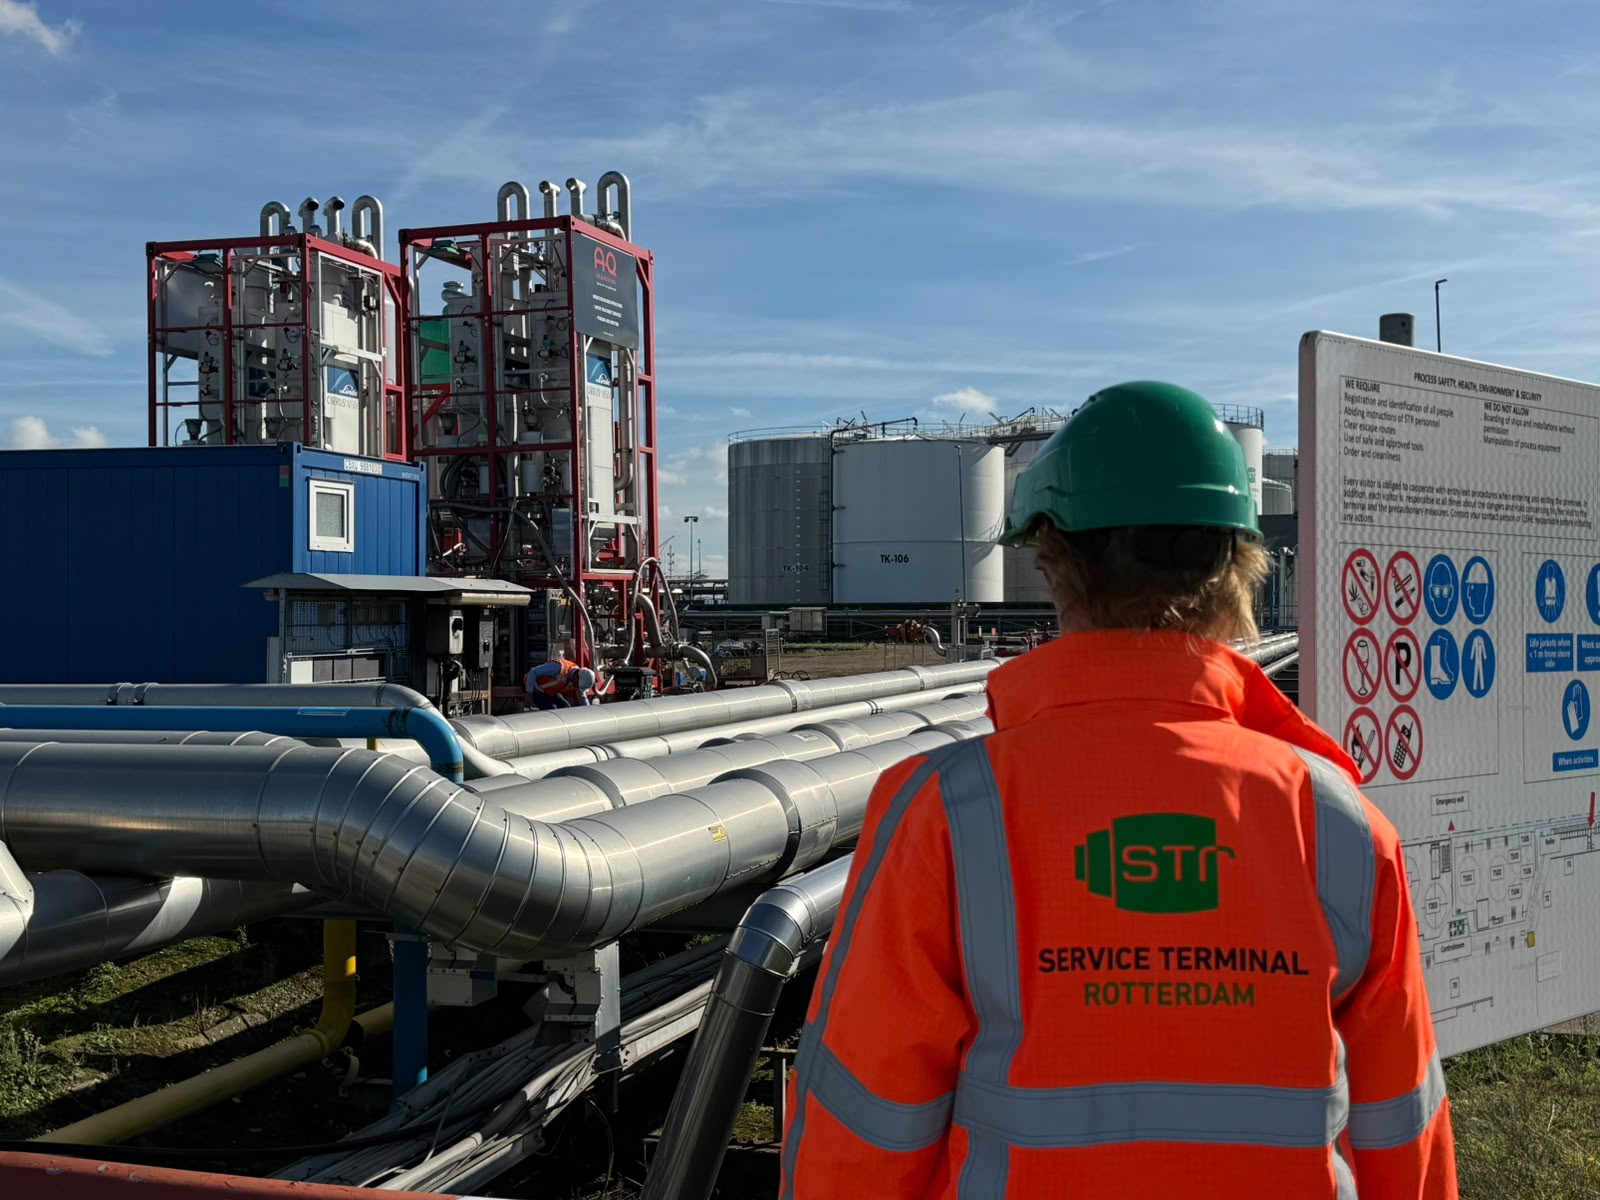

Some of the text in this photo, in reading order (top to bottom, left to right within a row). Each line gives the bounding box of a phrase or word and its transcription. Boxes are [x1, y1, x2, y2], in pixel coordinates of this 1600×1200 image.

[1345, 379, 1380, 393] WE REQUIRE
[1414, 372, 1542, 402] PROCESS SAFETY, HEALTH, ENVIRONMENT & SECURITY
[1344, 392, 1376, 404] Registration
[1378, 399, 1387, 407] and
[1389, 400, 1422, 412] identification
[1424, 404, 1428, 413] of
[1436, 408, 1454, 418] people
[1484, 402, 1529, 416] WE DO NOT ALLOW
[1344, 406, 1364, 420] Abiding
[1366, 408, 1396, 422] instructions
[1398, 414, 1403, 422] of
[1415, 417, 1440, 428] personnel
[1484, 412, 1504, 425] Boarding
[1506, 416, 1510, 424] of
[1511, 418, 1522, 427] ships
[1523, 420, 1531, 428] and
[1559, 424, 1575, 434] without
[1344, 419, 1396, 435] Clear escape routes
[1344, 432, 1424, 452] Use of safe and approved tools
[1484, 436, 1514, 447] Manipulation
[1514, 439, 1520, 448] of
[1520, 441, 1536, 450] process
[1344, 446, 1400, 462] Order and cleanliness
[1344, 476, 1358, 488] Every
[1360, 478, 1376, 488] visitor
[1382, 480, 1401, 492] obliged
[1402, 483, 1408, 491] to
[1409, 484, 1434, 494] cooperate
[1368, 491, 1380, 500] each
[1406, 494, 1434, 504] responsible
[1344, 501, 1366, 510] terminal
[1368, 502, 1378, 512] and
[1378, 504, 1388, 512] the
[1344, 513, 1353, 522] any
[880, 554, 910, 564] TK-106
[1540, 637, 1556, 649] jackets
[1558, 637, 1570, 647] when
[1582, 640, 1594, 648] Work
[1544, 649, 1556, 658] from
[1038, 946, 1310, 975] SERVICE TERMINAL
[1084, 982, 1255, 1006] ROTTERDAM
